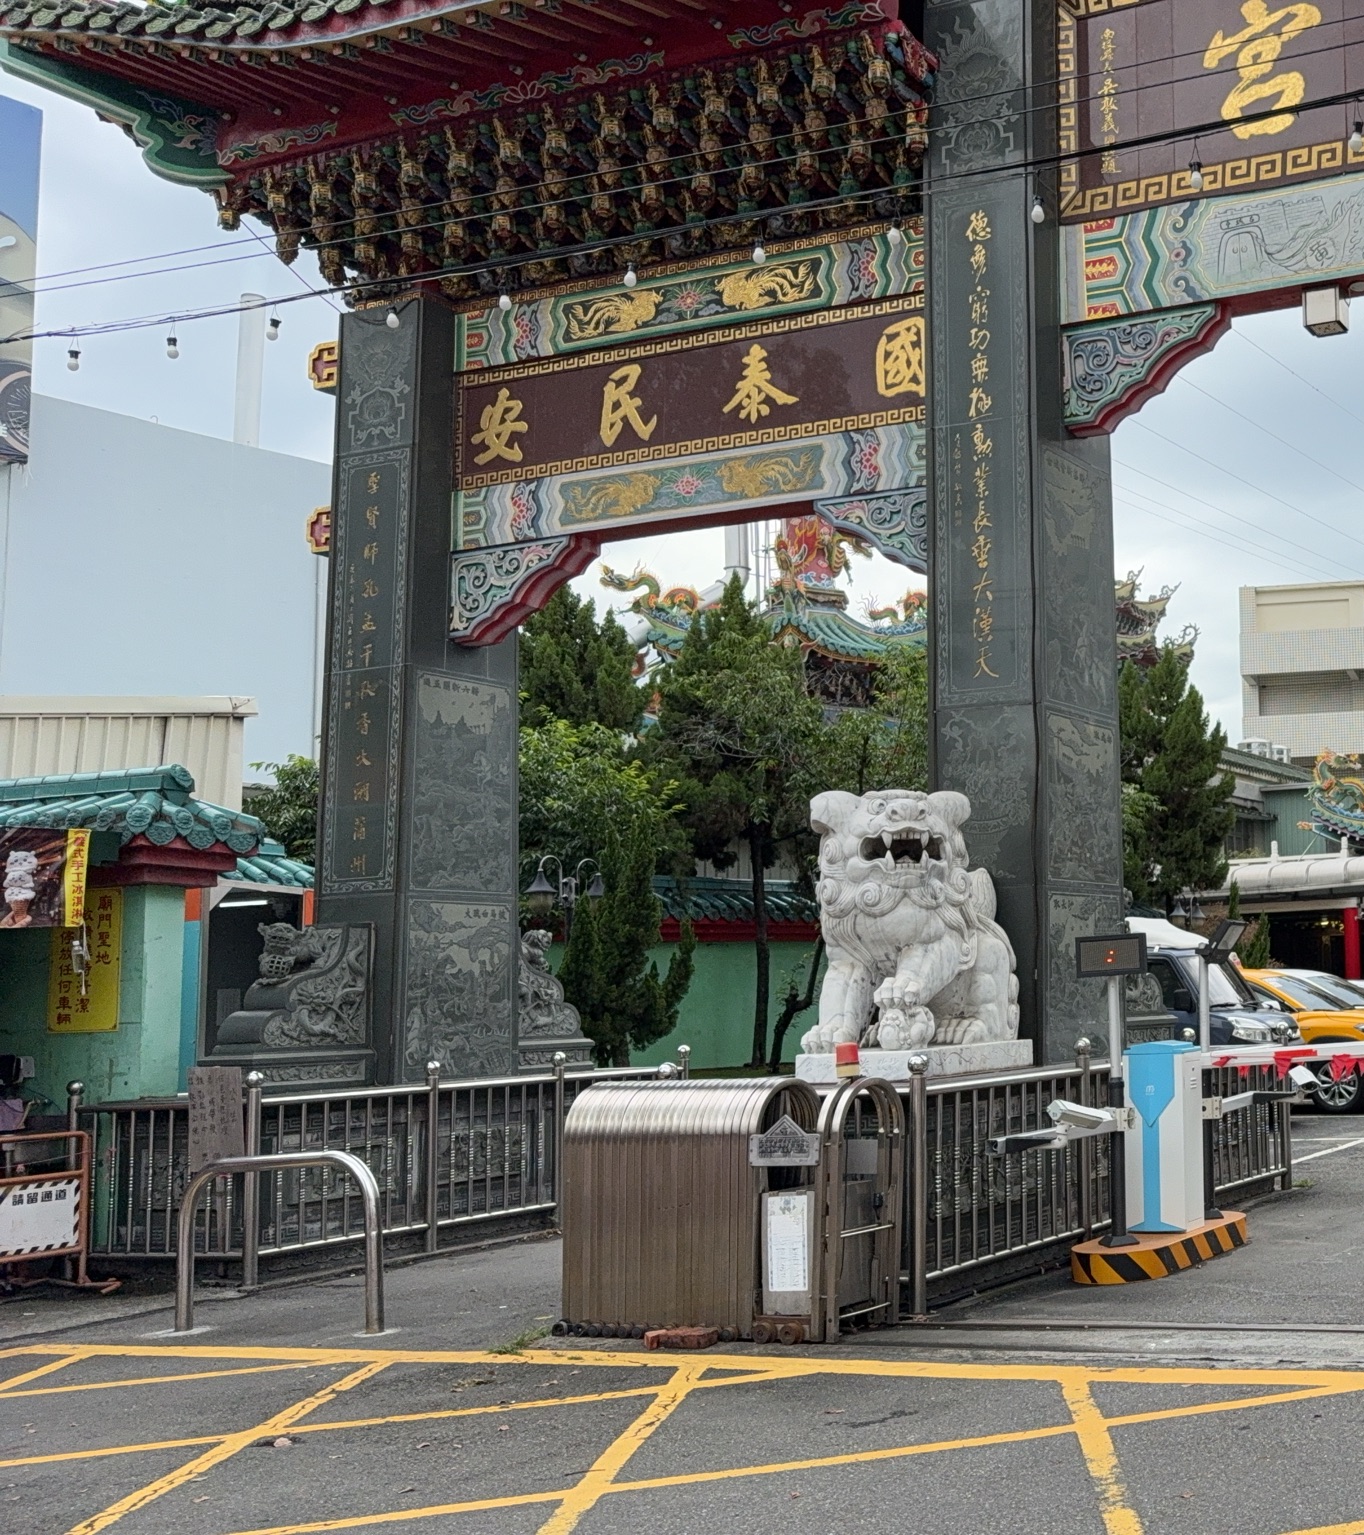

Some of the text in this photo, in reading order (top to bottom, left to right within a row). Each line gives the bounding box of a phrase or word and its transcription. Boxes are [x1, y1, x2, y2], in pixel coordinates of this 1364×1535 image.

[96, 894, 112, 966] 廟門聖地
[12, 1188, 67, 1207] 請留通道
